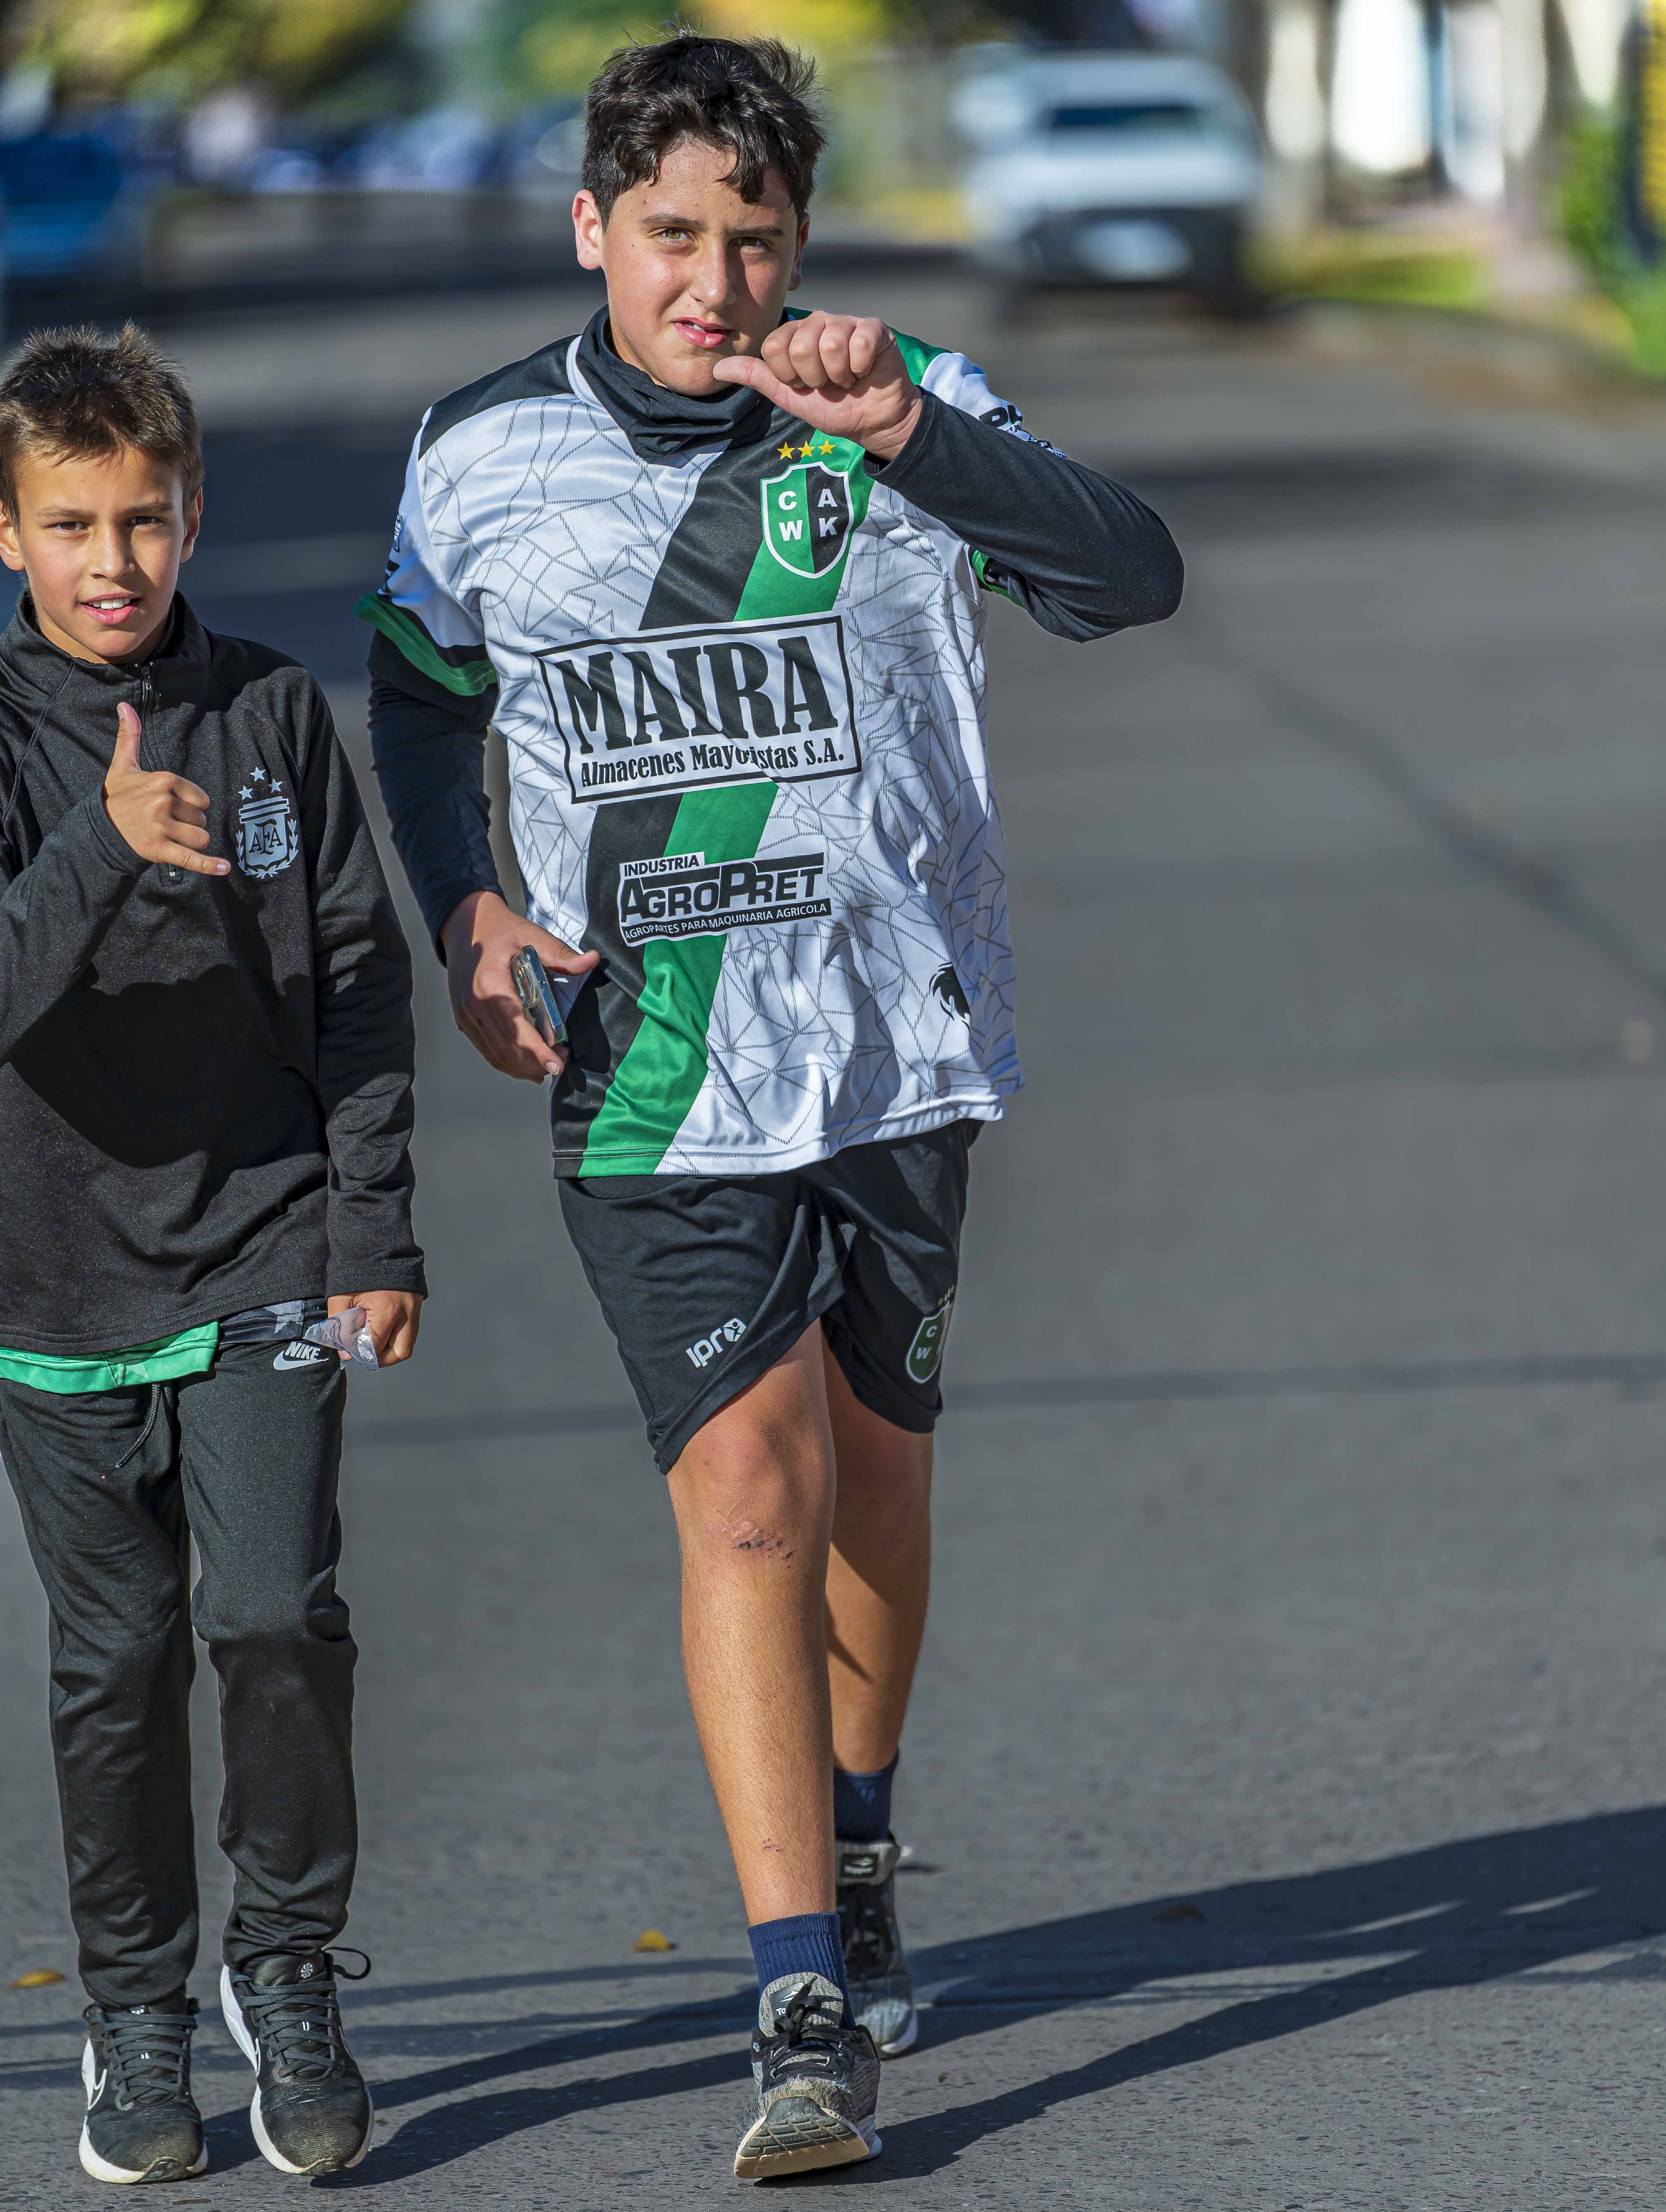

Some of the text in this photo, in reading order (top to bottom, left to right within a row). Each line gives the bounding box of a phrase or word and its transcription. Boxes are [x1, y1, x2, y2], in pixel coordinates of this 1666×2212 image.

[552, 636, 838, 755] MAIRA
[581, 749, 686, 788] Almacenes
[803, 738, 844, 765] S.A.
[248, 818, 283, 855] AFA
[624, 855, 700, 877] INDUSTRIA
[625, 903, 827, 939] AGROPARTES PARA MAQUINARIA AGRICOLA
[284, 1341, 321, 1360] NIKE
